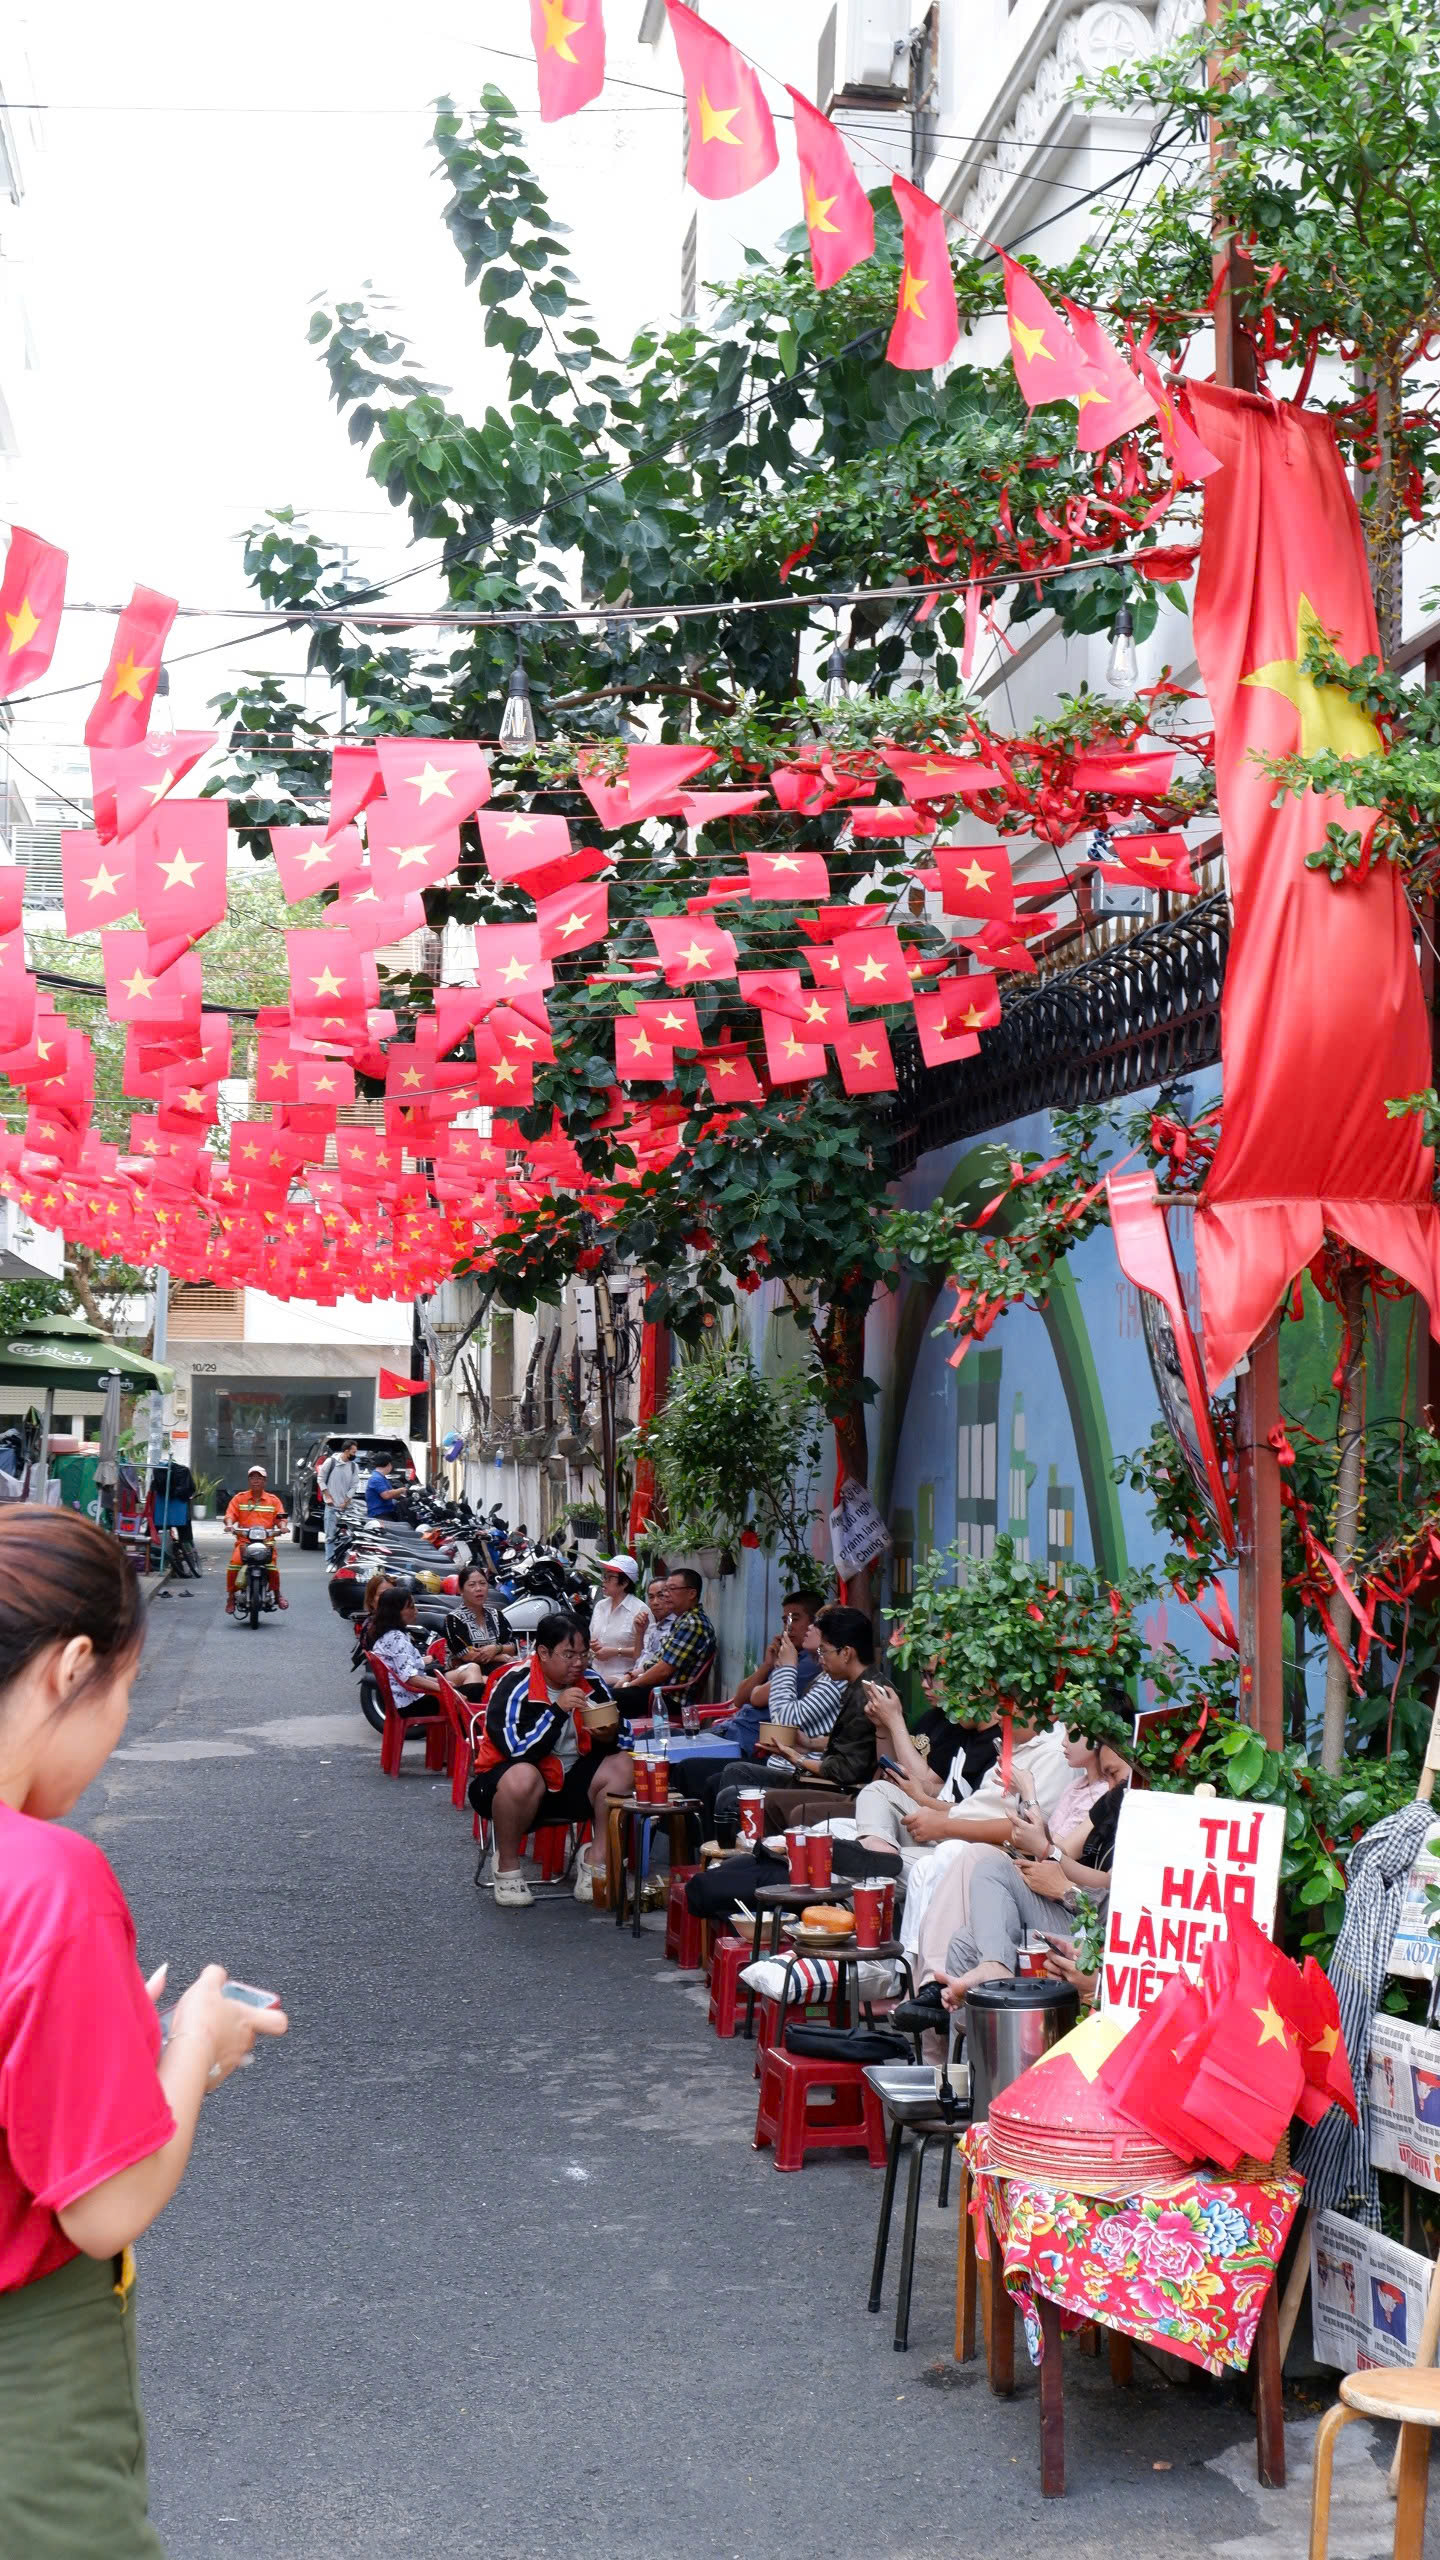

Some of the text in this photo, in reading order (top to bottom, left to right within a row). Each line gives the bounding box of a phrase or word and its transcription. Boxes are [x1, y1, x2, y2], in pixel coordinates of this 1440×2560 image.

[7, 1342, 94, 1365] Carlsberg
[192, 1363, 217, 1372] 10/29
[856, 1539, 885, 1563] Chung
[1199, 1812, 1265, 1872] TỰ
[1161, 1862, 1256, 1917] HÀO
